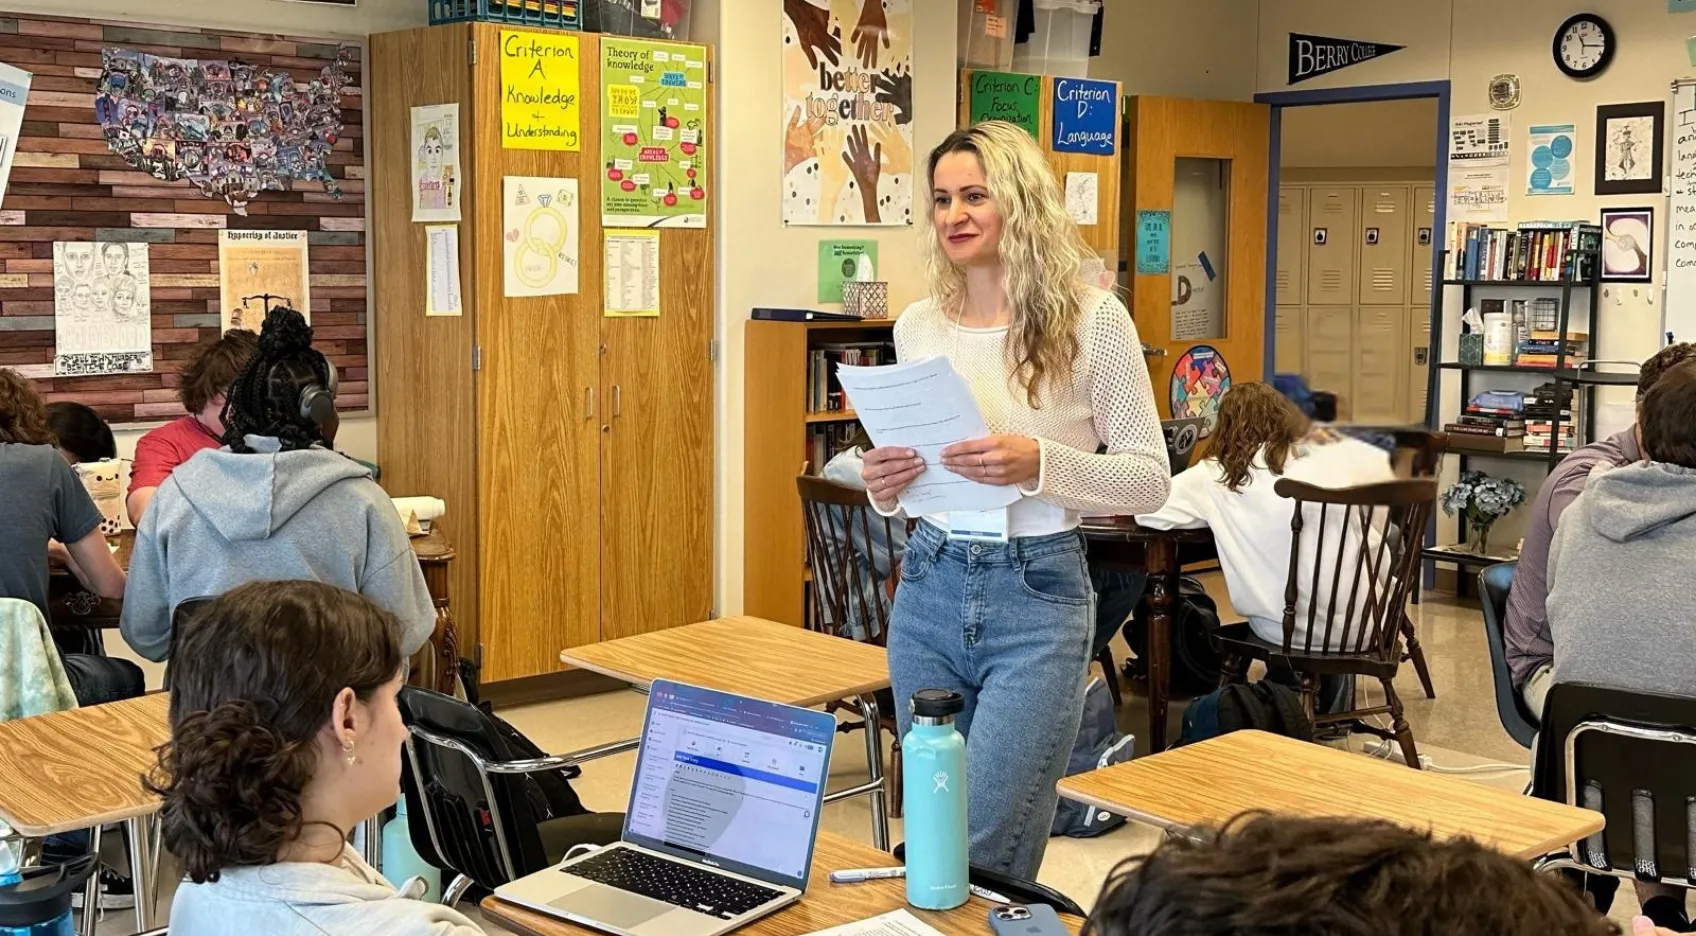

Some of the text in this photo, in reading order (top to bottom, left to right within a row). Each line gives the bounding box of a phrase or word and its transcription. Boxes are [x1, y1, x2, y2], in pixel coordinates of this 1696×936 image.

[1581, 22, 1587, 30] 12
[505, 35, 574, 59] Criterion
[607, 46, 638, 60] Theory
[640, 50, 650, 59] of
[1295, 39, 1350, 76] BERRY
[528, 59, 546, 80] A
[607, 58, 654, 73] knowledge
[820, 61, 881, 93] better
[976, 75, 1038, 95] Criterion C:
[0, 88, 16, 98] ons
[507, 84, 575, 110] Knowledge
[1057, 80, 1111, 103] Criterion
[805, 92, 894, 126] together
[1078, 100, 1093, 119] D:
[1679, 109, 1695, 127] I
[506, 122, 577, 146] Understanding
[1057, 121, 1113, 148] Language
[228, 231, 263, 240] Hypocrisy
